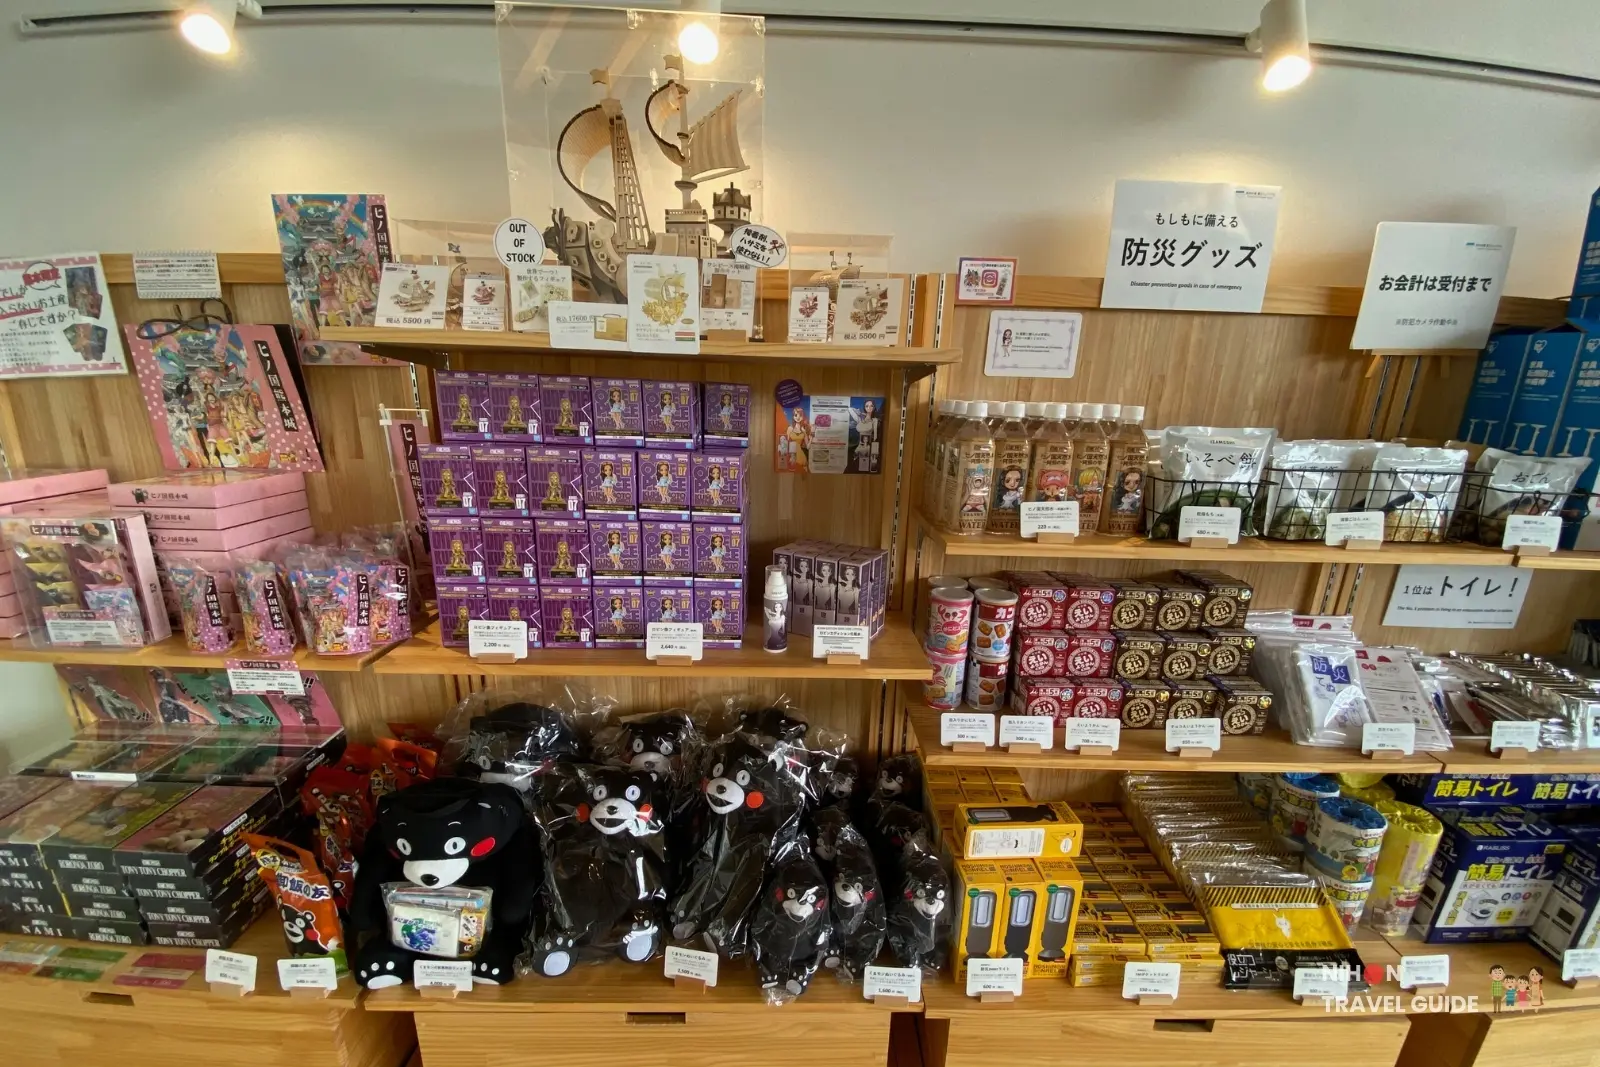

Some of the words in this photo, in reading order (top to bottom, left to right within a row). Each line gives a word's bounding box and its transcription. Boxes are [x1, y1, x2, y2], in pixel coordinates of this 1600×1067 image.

[1155, 213, 1239, 228] もしもに備える
[509, 223, 527, 233] OUT
[513, 238, 526, 248] OF
[739, 236, 768, 253] ハサミを
[506, 253, 536, 263] STOCK
[1121, 237, 1263, 269] 防災グッズ
[1178, 282, 1193, 290] goods
[1378, 274, 1493, 293] お会計は受付まで
[402, 317, 422, 325] 5500
[858, 332, 877, 340] 5500
[256, 343, 297, 430] ヒノ国熊本城
[1512, 471, 1553, 484] おでん
[265, 581, 284, 629] ヒノ国熊本城
[359, 575, 370, 625] ヒノ国熊本城
[1313, 658, 1348, 683] 防災
[1433, 779, 1519, 798] 簡易トイレ
[0, 856, 29, 867] AMI
[157, 868, 187, 878] CHOPPER
[1464, 864, 1554, 881] 簡易トイレ
[276, 872, 331, 901] 御飯の友
[171, 890, 201, 900] CHOPPER
[12, 902, 54, 914] NAMI
[181, 914, 211, 924] CHOPPER
[21, 925, 63, 937] NAMI
[191, 938, 221, 947] CHOPPER
